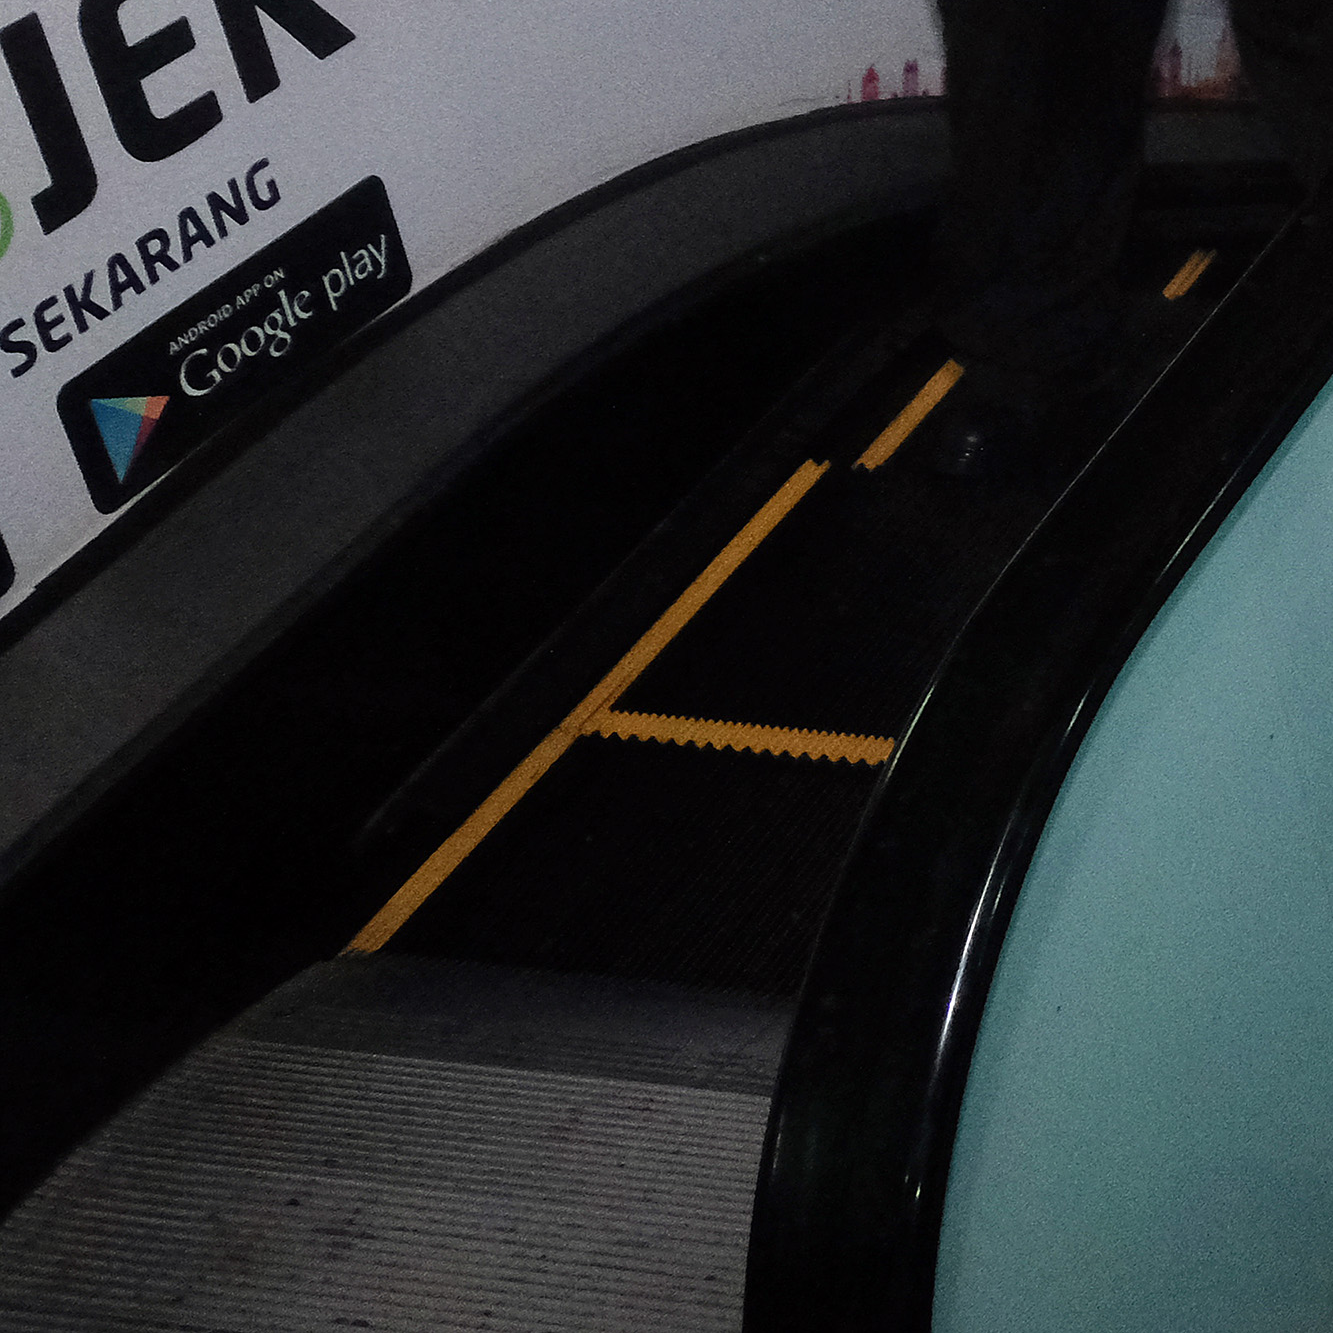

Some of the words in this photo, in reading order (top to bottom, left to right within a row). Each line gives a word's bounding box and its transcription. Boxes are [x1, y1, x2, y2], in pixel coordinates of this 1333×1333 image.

[0, 157, 281, 379] SEKARANG
[169, 303, 234, 356] ANDROID
[235, 282, 262, 310] APP
[263, 267, 286, 289] ON
[179, 289, 314, 397] Google
[322, 233, 386, 312] play
